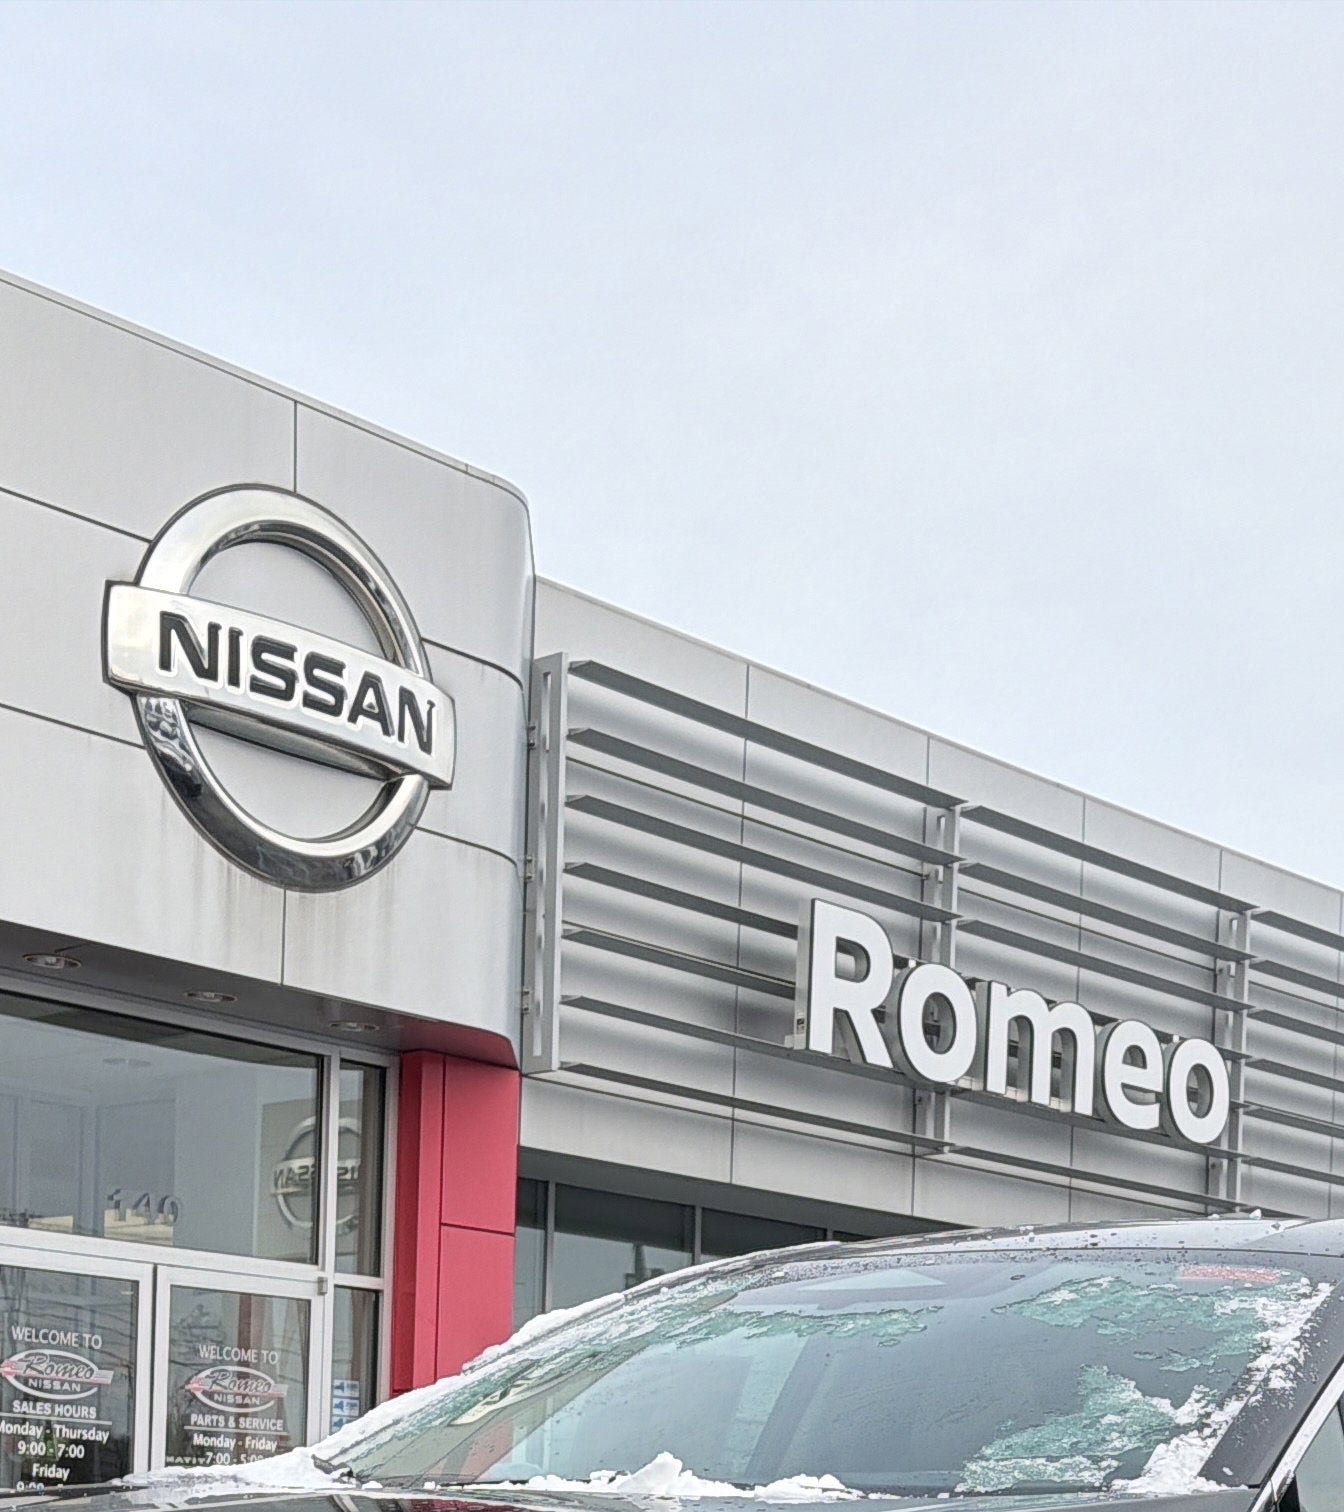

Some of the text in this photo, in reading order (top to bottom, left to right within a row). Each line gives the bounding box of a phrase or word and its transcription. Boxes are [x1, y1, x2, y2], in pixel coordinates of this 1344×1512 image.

[158, 610, 436, 756] NISSAN
[807, 898, 1231, 1144] Romeo
[11, 1325, 103, 1350] WELCOME TO
[198, 1344, 279, 1365] WELCOME TO
[22, 1352, 95, 1380] Romeo
[28, 1378, 81, 1393] NISSAN
[207, 1368, 272, 1393] Romeo
[214, 1393, 260, 1405] NISSAN
[12, 1400, 97, 1419] SALES HOURS
[190, 1413, 284, 1431] PARTS & SERVICE
[53, 1424, 110, 1444] Thursday
[193, 1433, 236, 1450] Monday
[245, 1436, 278, 1453] Friday
[17, 1440, 46, 1455] 9:00
[57, 1443, 85, 1459] 7:00
[205, 1452, 231, 1465] 7:00
[32, 1463, 71, 1481] Friday
